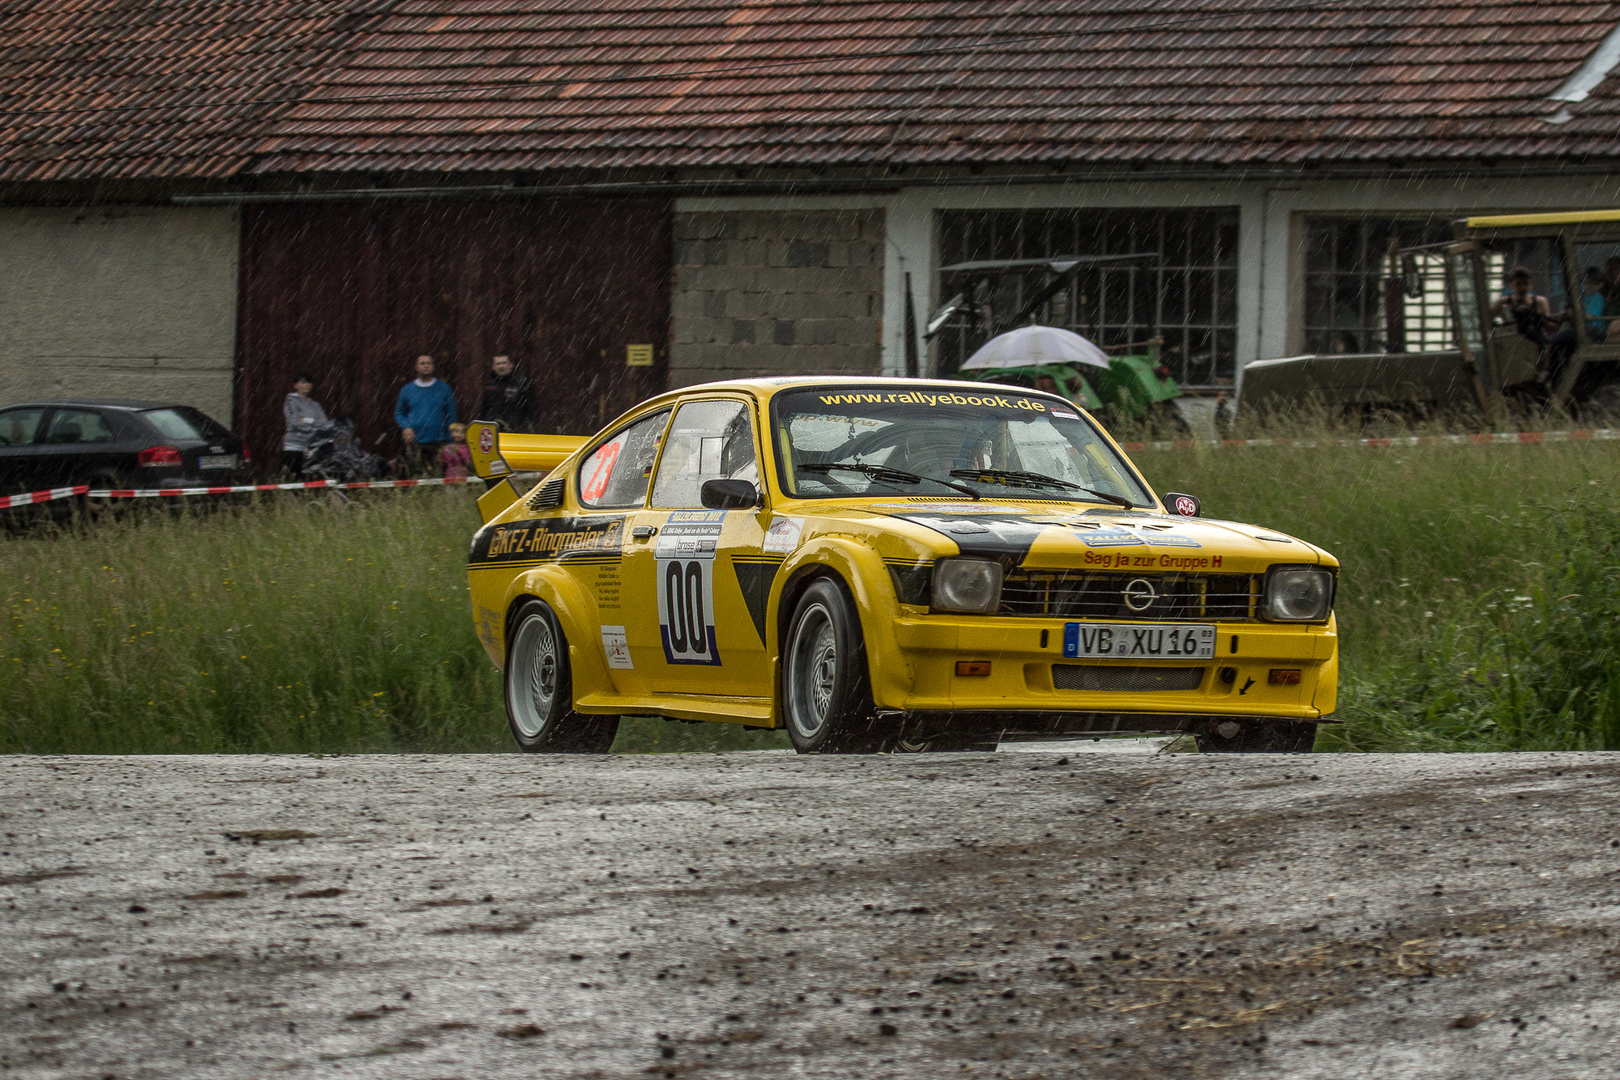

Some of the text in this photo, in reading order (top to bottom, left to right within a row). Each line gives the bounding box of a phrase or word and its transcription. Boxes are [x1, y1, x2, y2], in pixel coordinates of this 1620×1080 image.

[819, 391, 1046, 412] www.rallyebook.de
[498, 526, 604, 557] KFZ-Ringmaier
[1084, 550, 1223, 570] Sag ja zur Gruppe H
[666, 560, 706, 654] 00
[1081, 627, 1113, 654] VB
